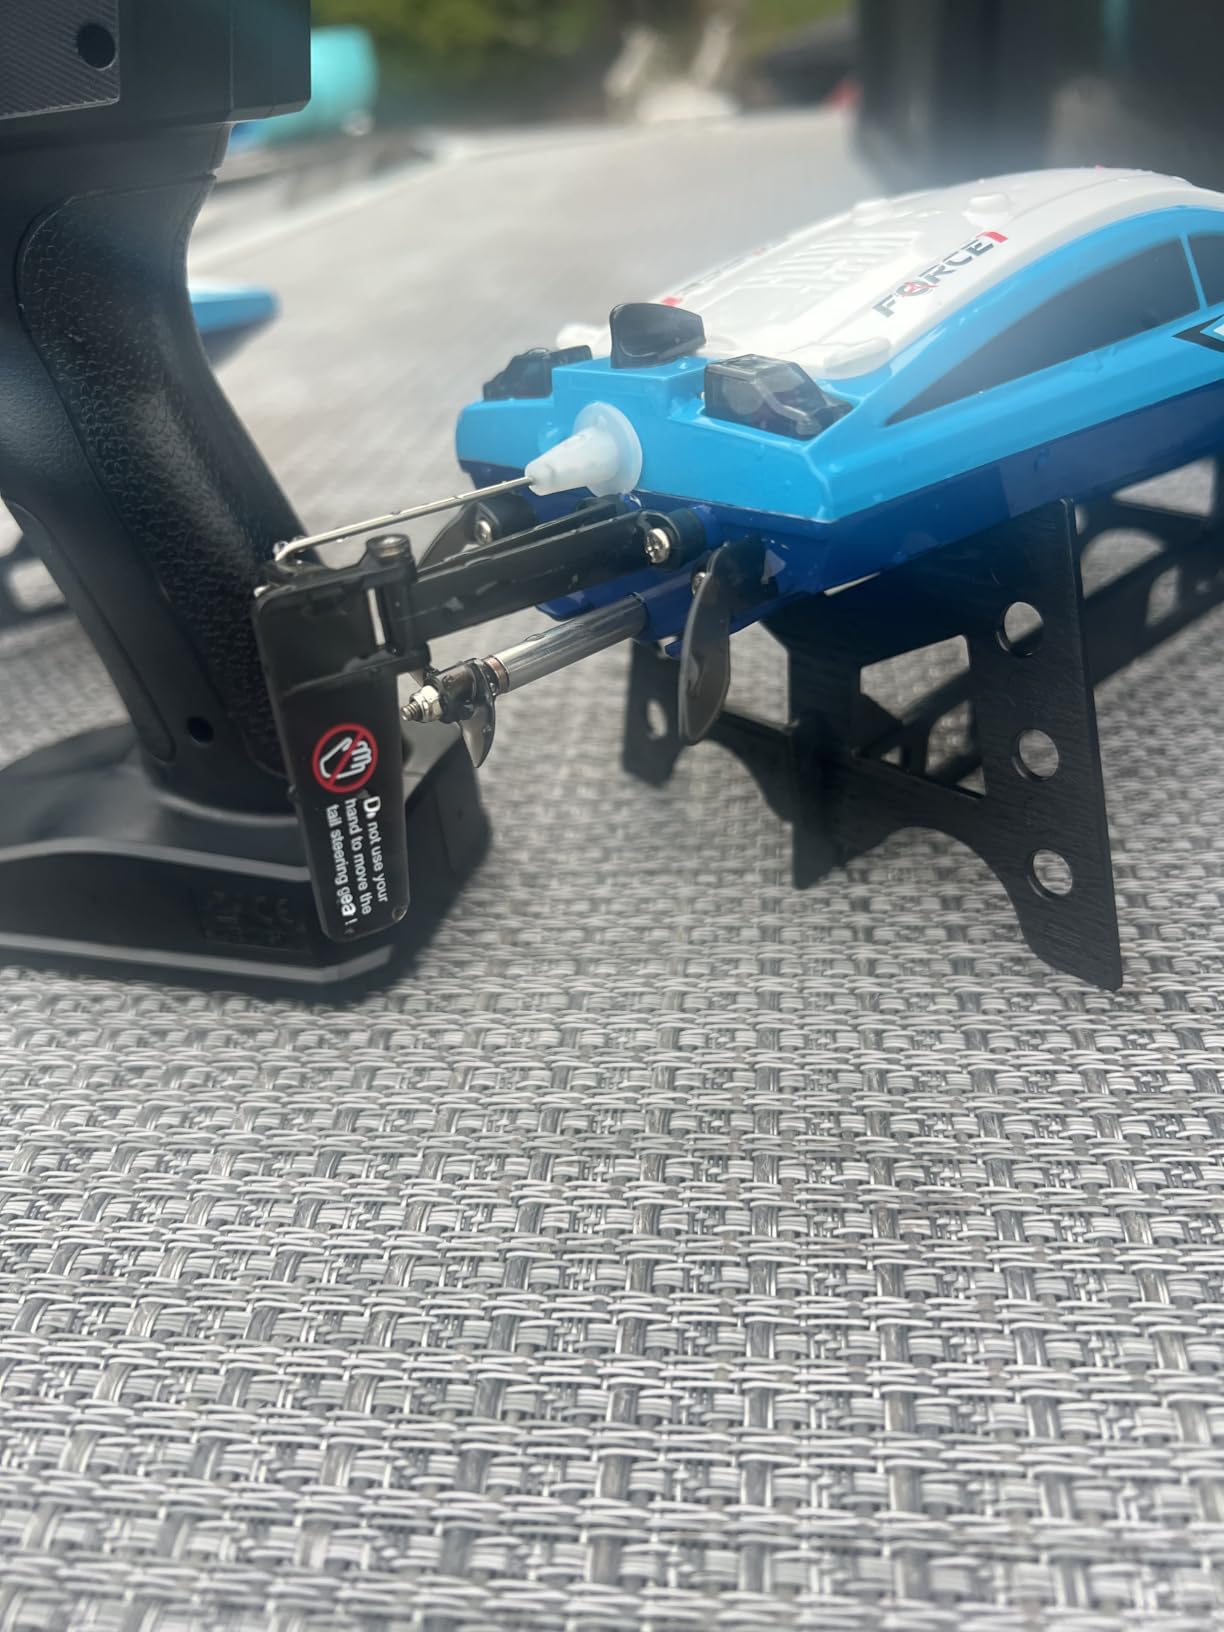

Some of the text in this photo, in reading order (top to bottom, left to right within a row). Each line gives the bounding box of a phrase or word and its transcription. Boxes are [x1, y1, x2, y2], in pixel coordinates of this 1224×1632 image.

[326, 804, 343, 828] tail
[367, 822, 382, 845] not
[330, 829, 349, 885] steering
[345, 798, 373, 915] hand to move the
[371, 846, 384, 871] use
[372, 873, 388, 902] your
